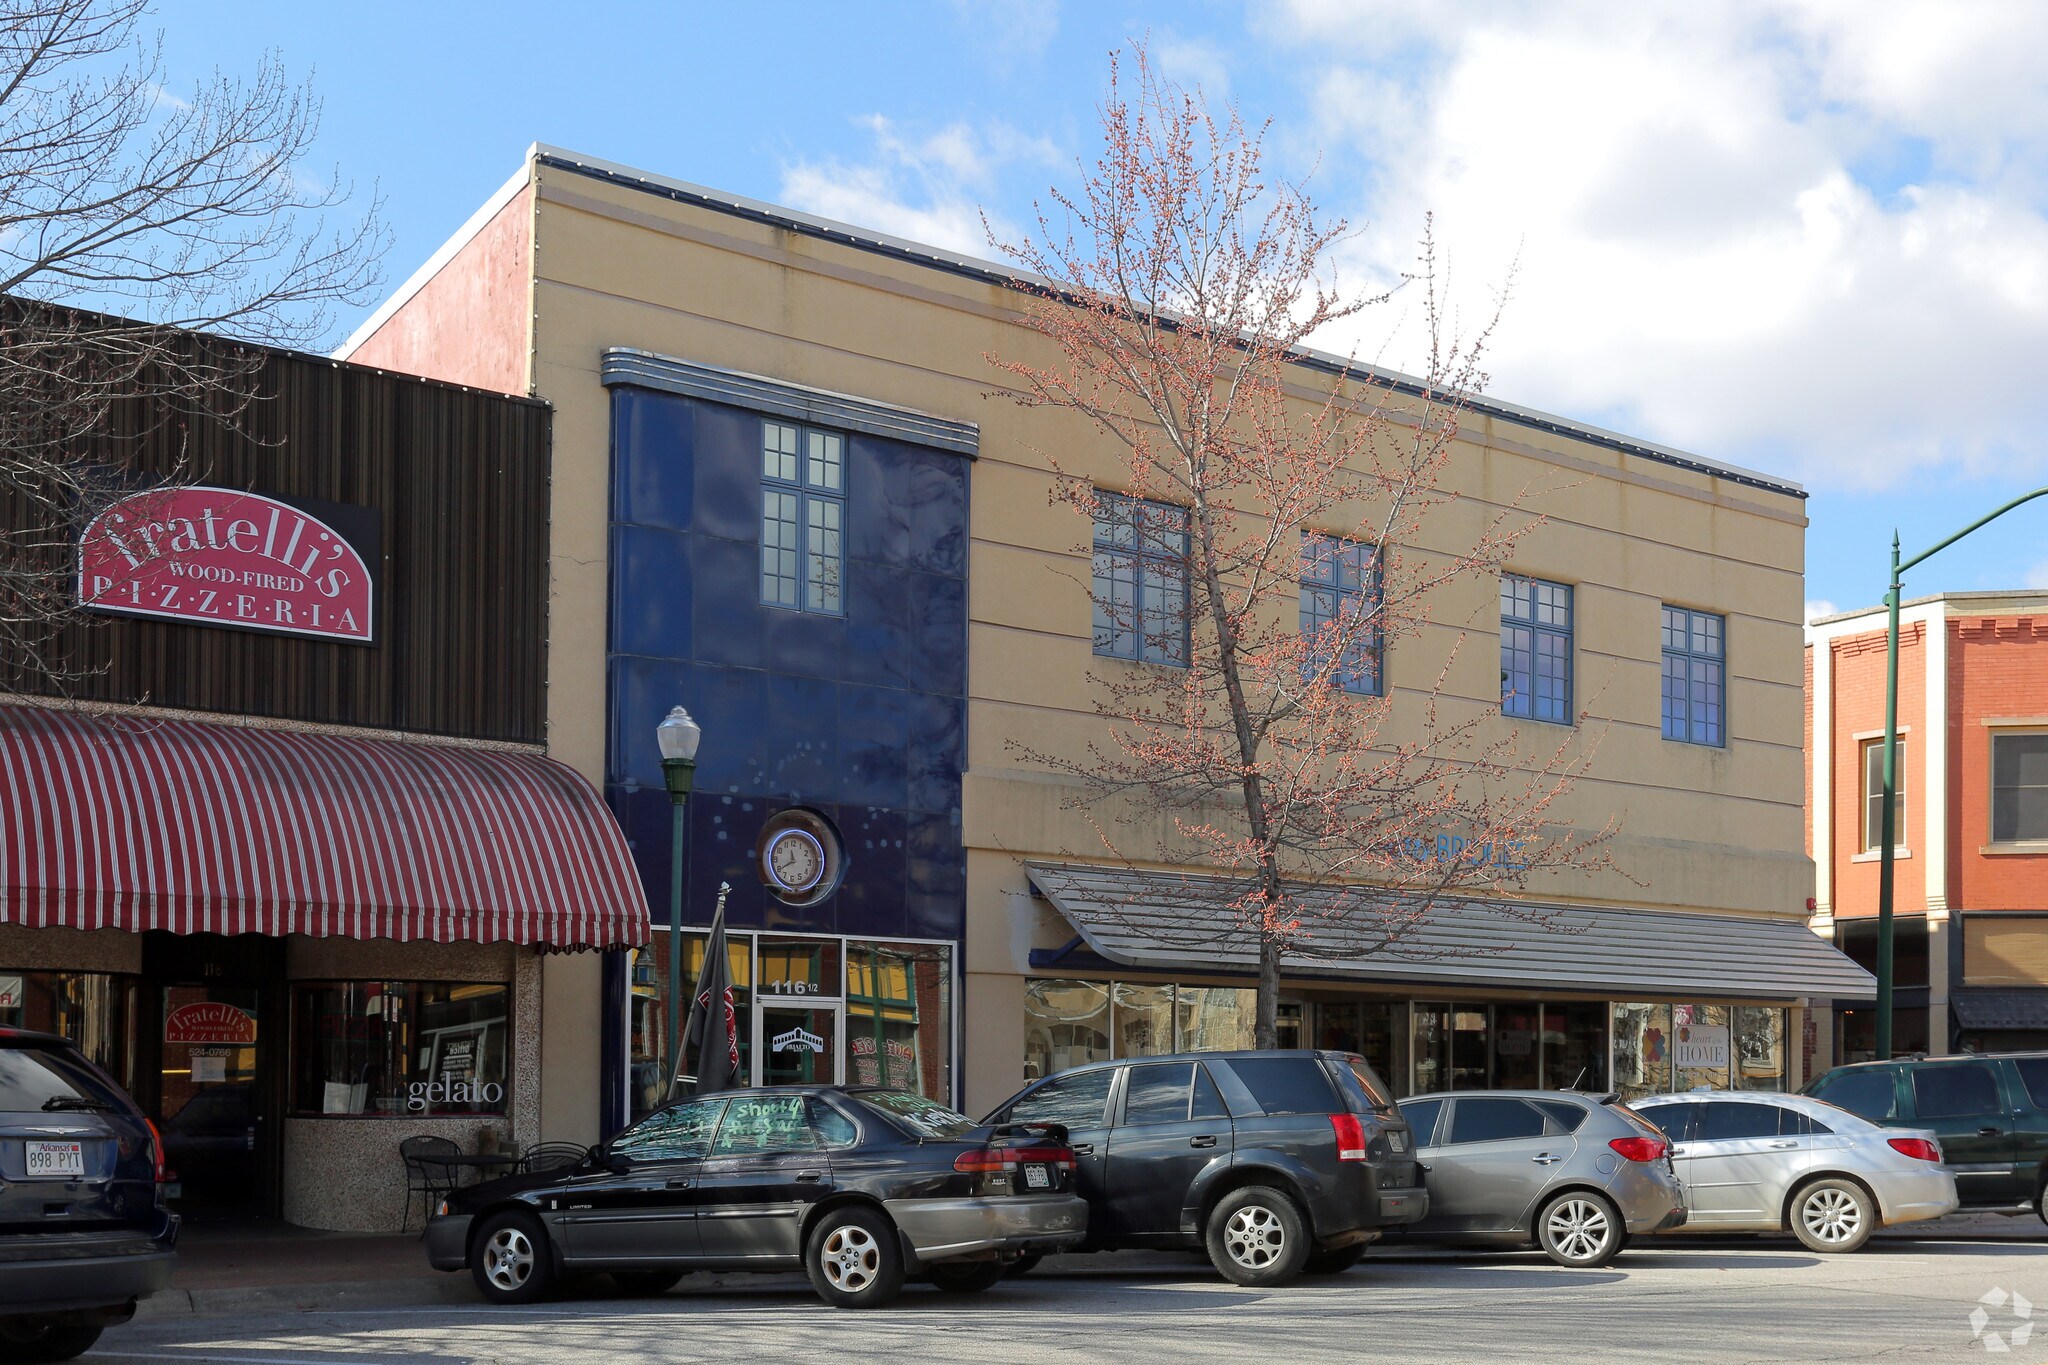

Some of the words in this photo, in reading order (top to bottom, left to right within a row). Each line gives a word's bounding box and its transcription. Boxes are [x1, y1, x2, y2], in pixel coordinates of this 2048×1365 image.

[169, 560, 305, 593] WOOD-FIRED
[771, 979, 806, 994] 116
[807, 983, 818, 992] 1/2
[1691, 1032, 1712, 1043] heart
[188, 1047, 231, 1057] 524-0766
[1680, 1046, 1724, 1062] HOME
[407, 1071, 503, 1110] gelato
[39, 1144, 70, 1152] Arkansas
[30, 1152, 52, 1168] 898
[59, 1152, 80, 1168] PYT
